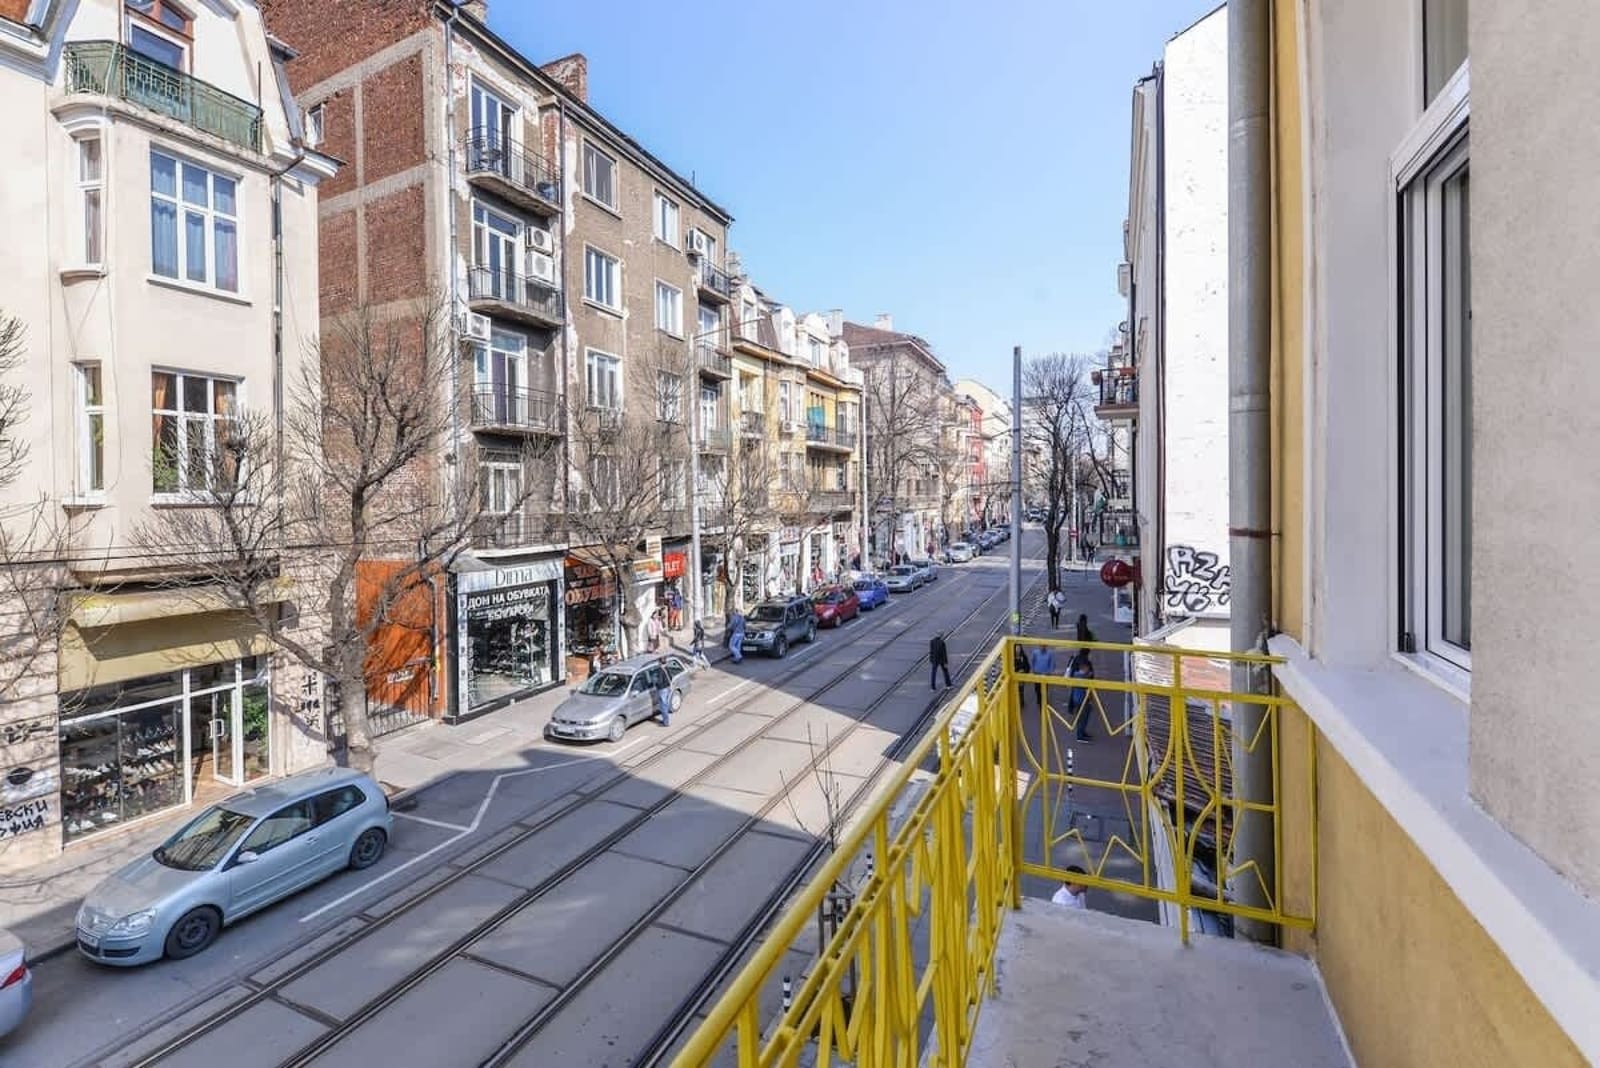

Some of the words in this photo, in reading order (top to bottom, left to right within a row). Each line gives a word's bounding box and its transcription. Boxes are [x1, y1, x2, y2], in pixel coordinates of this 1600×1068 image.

[495, 567, 533, 587] Dima
[467, 594, 490, 611] ДОМ
[492, 593, 505, 605] НА
